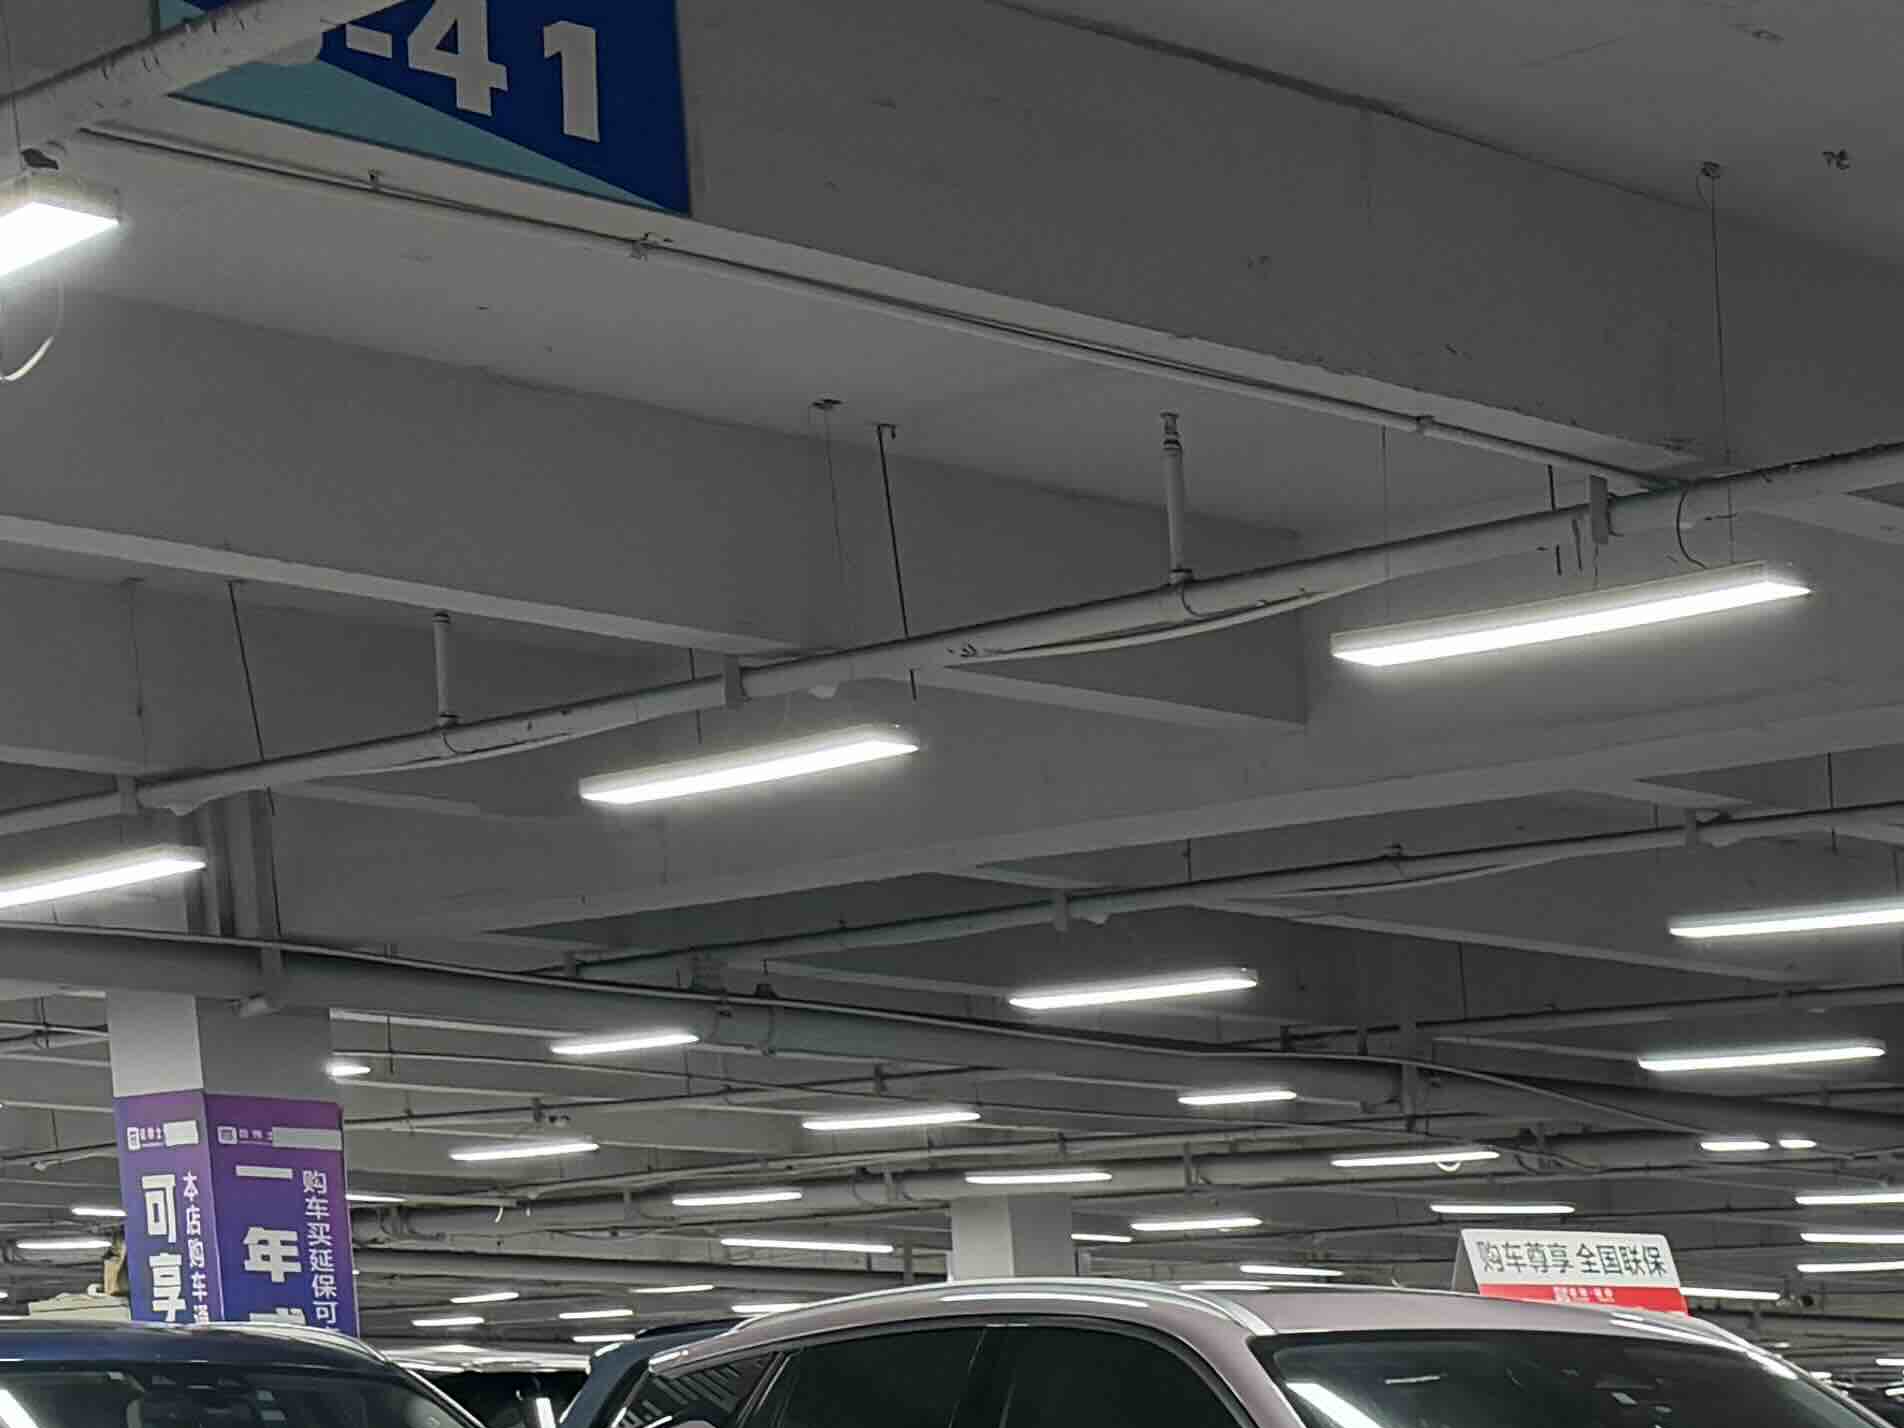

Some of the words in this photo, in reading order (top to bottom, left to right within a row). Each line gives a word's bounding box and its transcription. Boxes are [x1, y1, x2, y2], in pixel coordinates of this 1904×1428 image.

[141, 1173, 187, 1323] 可享
[302, 1170, 339, 1331] 购车买延保可
